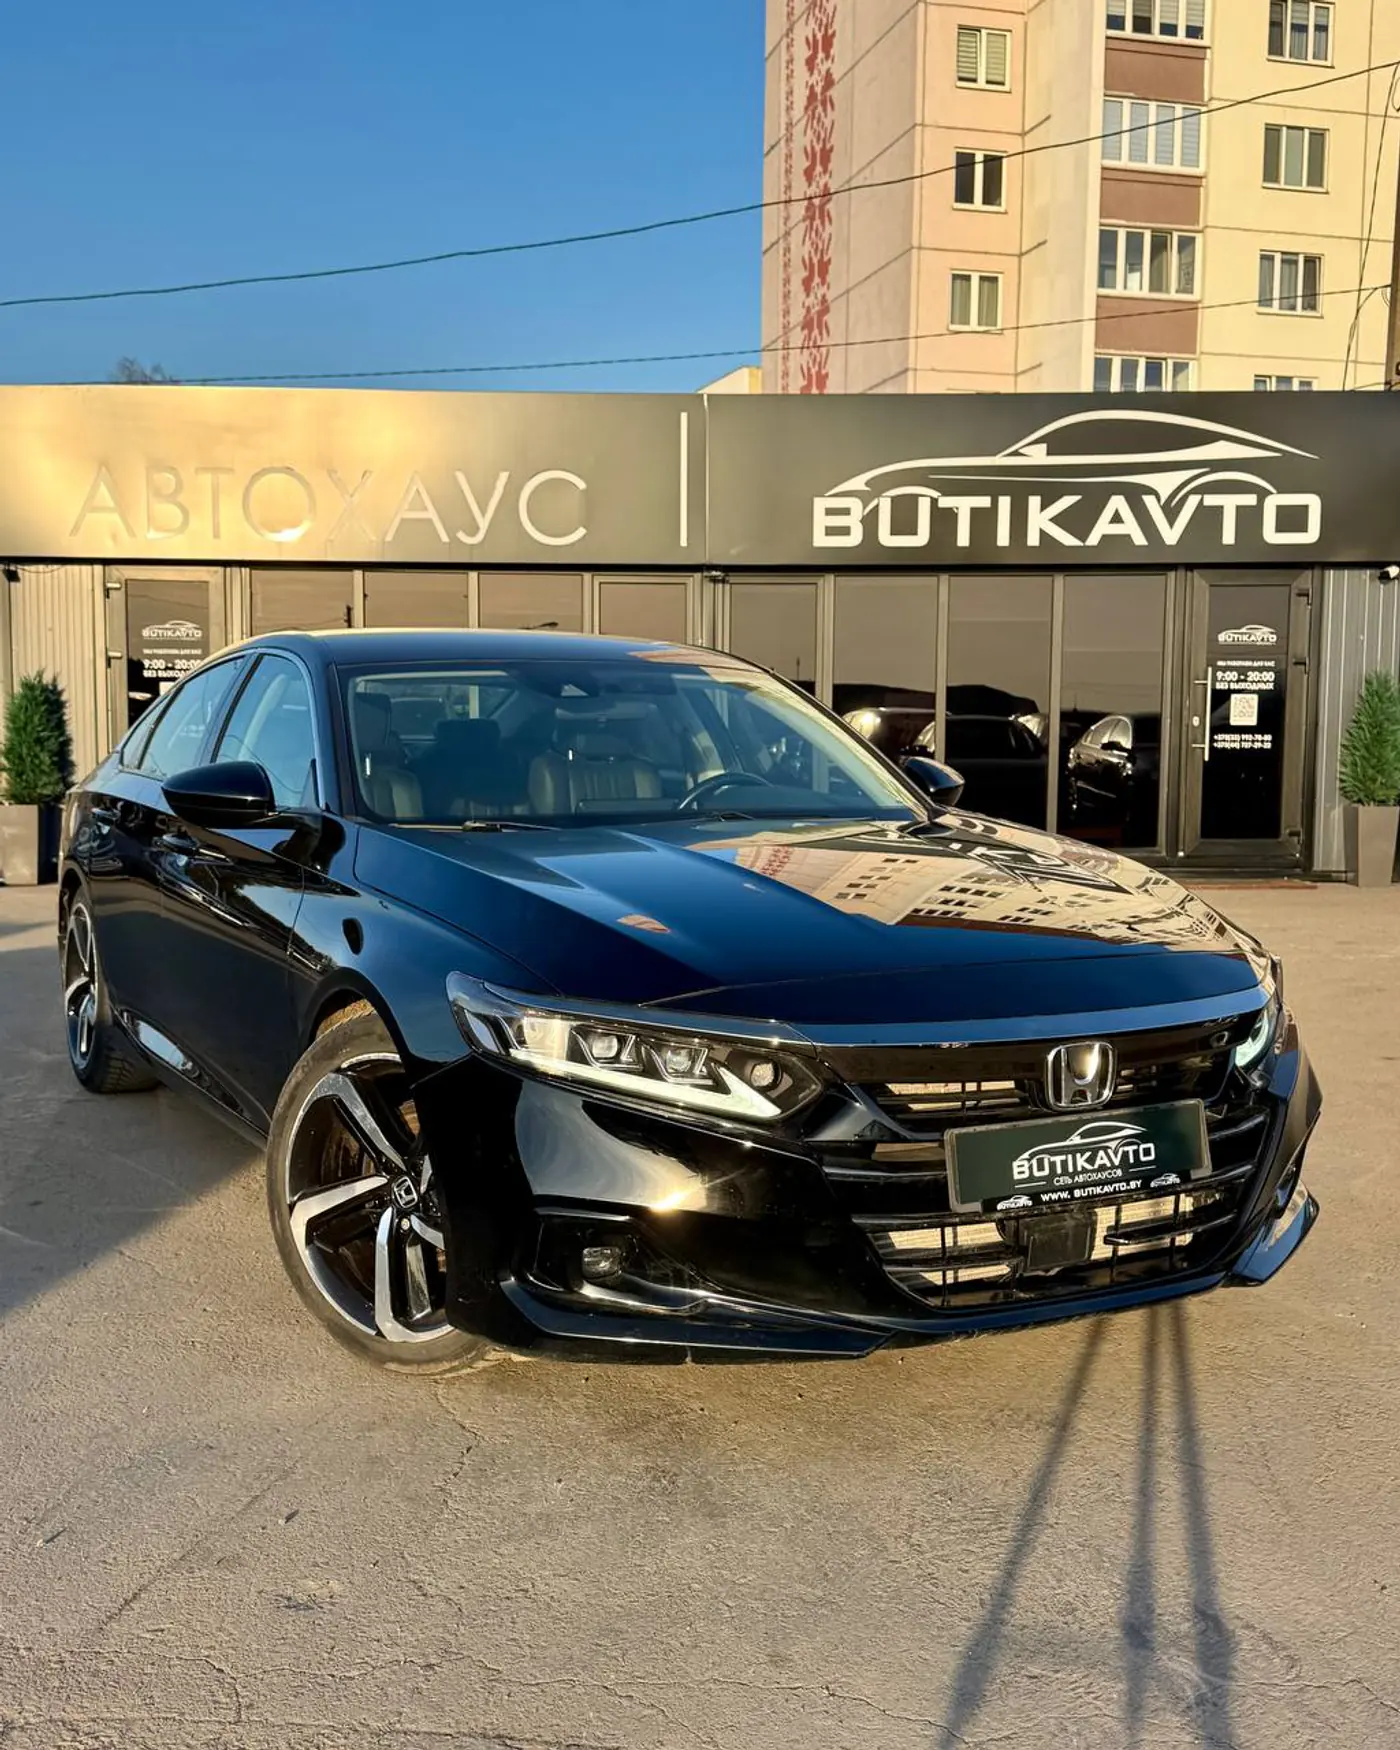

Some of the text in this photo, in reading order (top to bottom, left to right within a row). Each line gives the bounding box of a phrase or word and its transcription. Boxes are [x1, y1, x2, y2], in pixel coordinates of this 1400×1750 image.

[69, 465, 588, 547] АВТОХАУС
[812, 493, 1322, 548] BUTIKAVTO
[1217, 632, 1277, 642] BUTIKAVTO
[1216, 671, 1239, 681] 9:00
[1247, 671, 1275, 682] 20:00
[1216, 682, 1229, 690] БЕЗ
[1012, 1142, 1156, 1180] BUTIKAVTO
[1053, 1169, 1123, 1186] СЕТЬ АВТОХАУСОВ
[1041, 1179, 1142, 1202] WWW. BUTIKAVTO.BY
